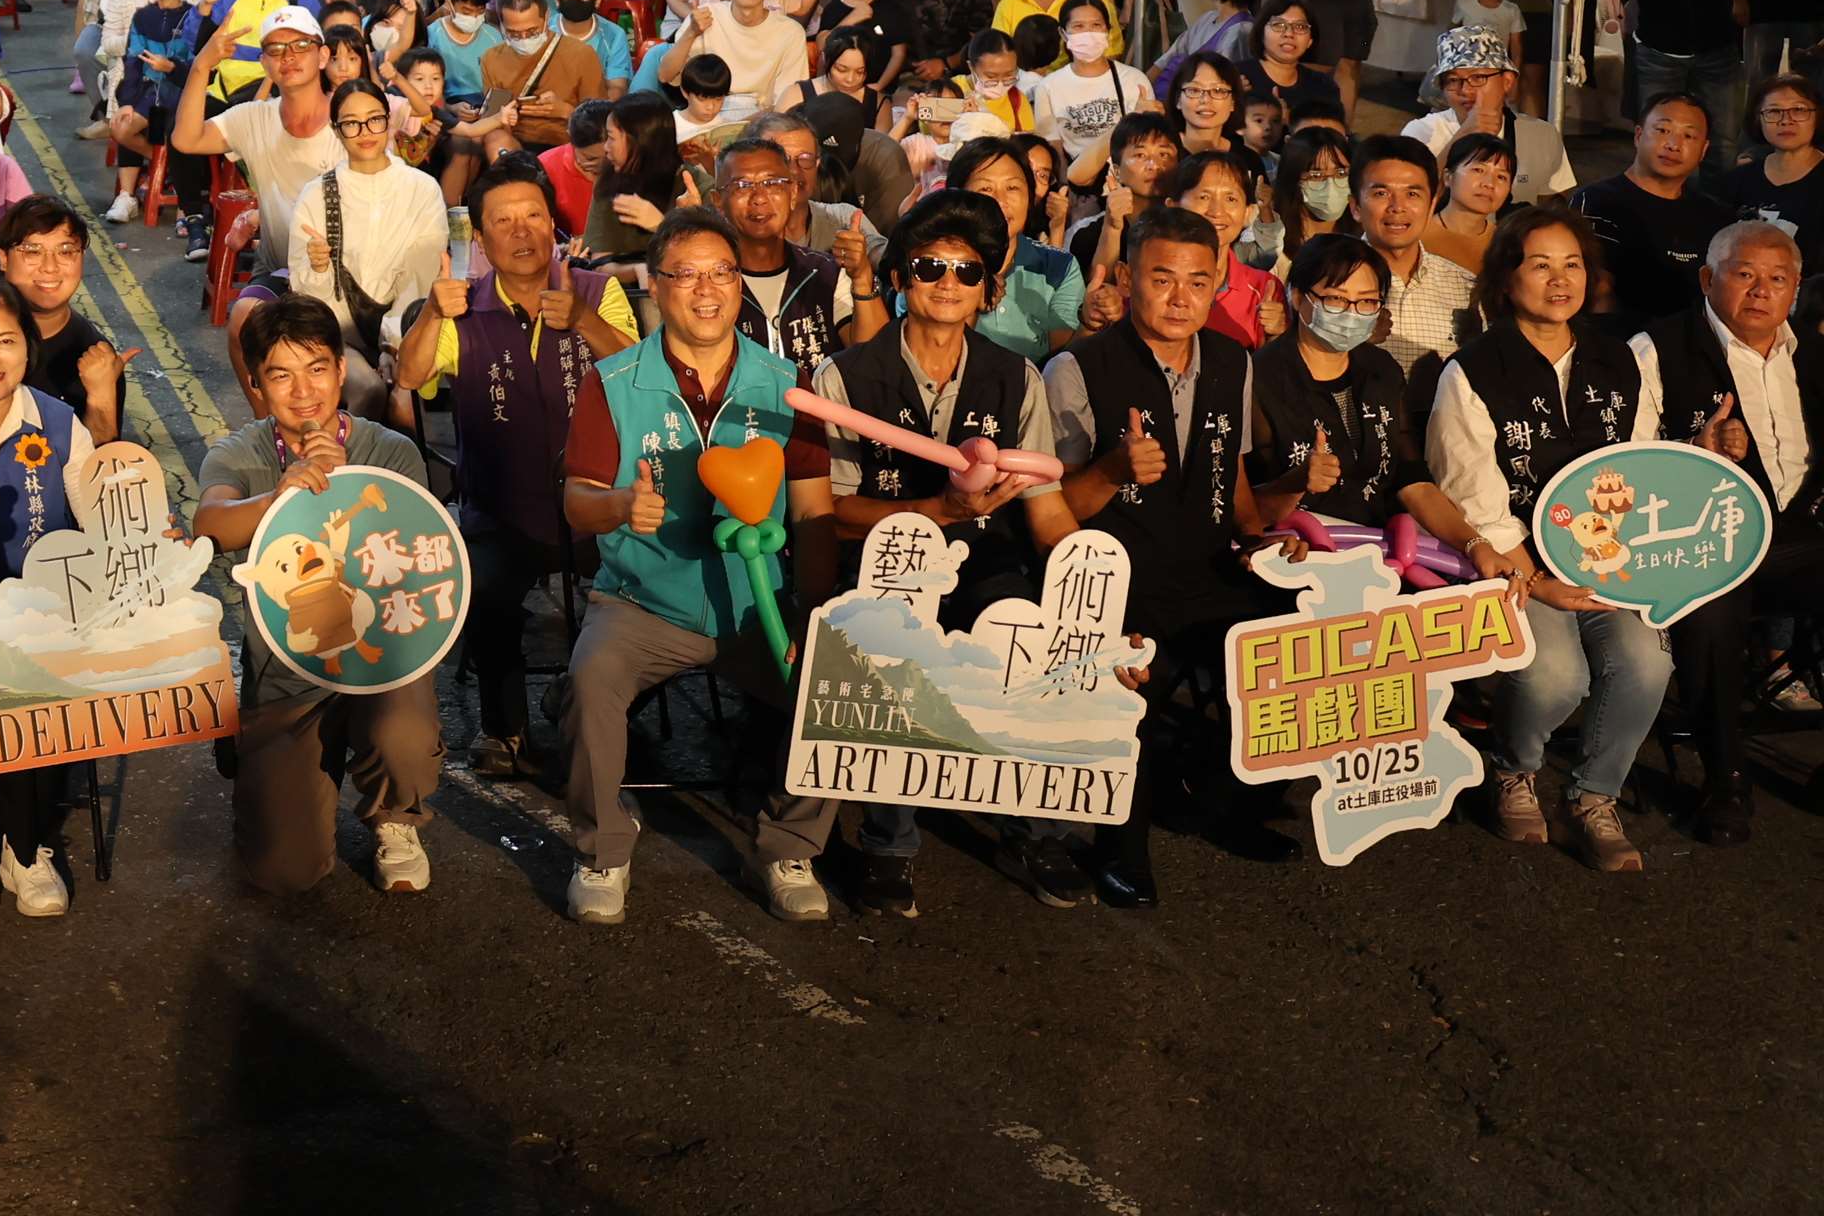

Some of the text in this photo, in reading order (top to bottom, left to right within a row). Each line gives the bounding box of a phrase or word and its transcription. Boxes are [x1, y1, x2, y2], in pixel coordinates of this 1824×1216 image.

[1068, 103, 1118, 119] LEISURE
[1077, 113, 1114, 125] CAFE
[664, 411, 683, 450] 鎮長
[1554, 508, 1572, 523] 80
[1628, 478, 1746, 563] 土庫
[1633, 540, 1718, 570] 生日快樂
[1241, 594, 1514, 692] FOCASA
[811, 698, 917, 735] YUNLIN
[1246, 670, 1419, 759] 馬戲團
[796, 744, 1130, 817] ART DELIVERY
[1335, 743, 1421, 785] 10/25
